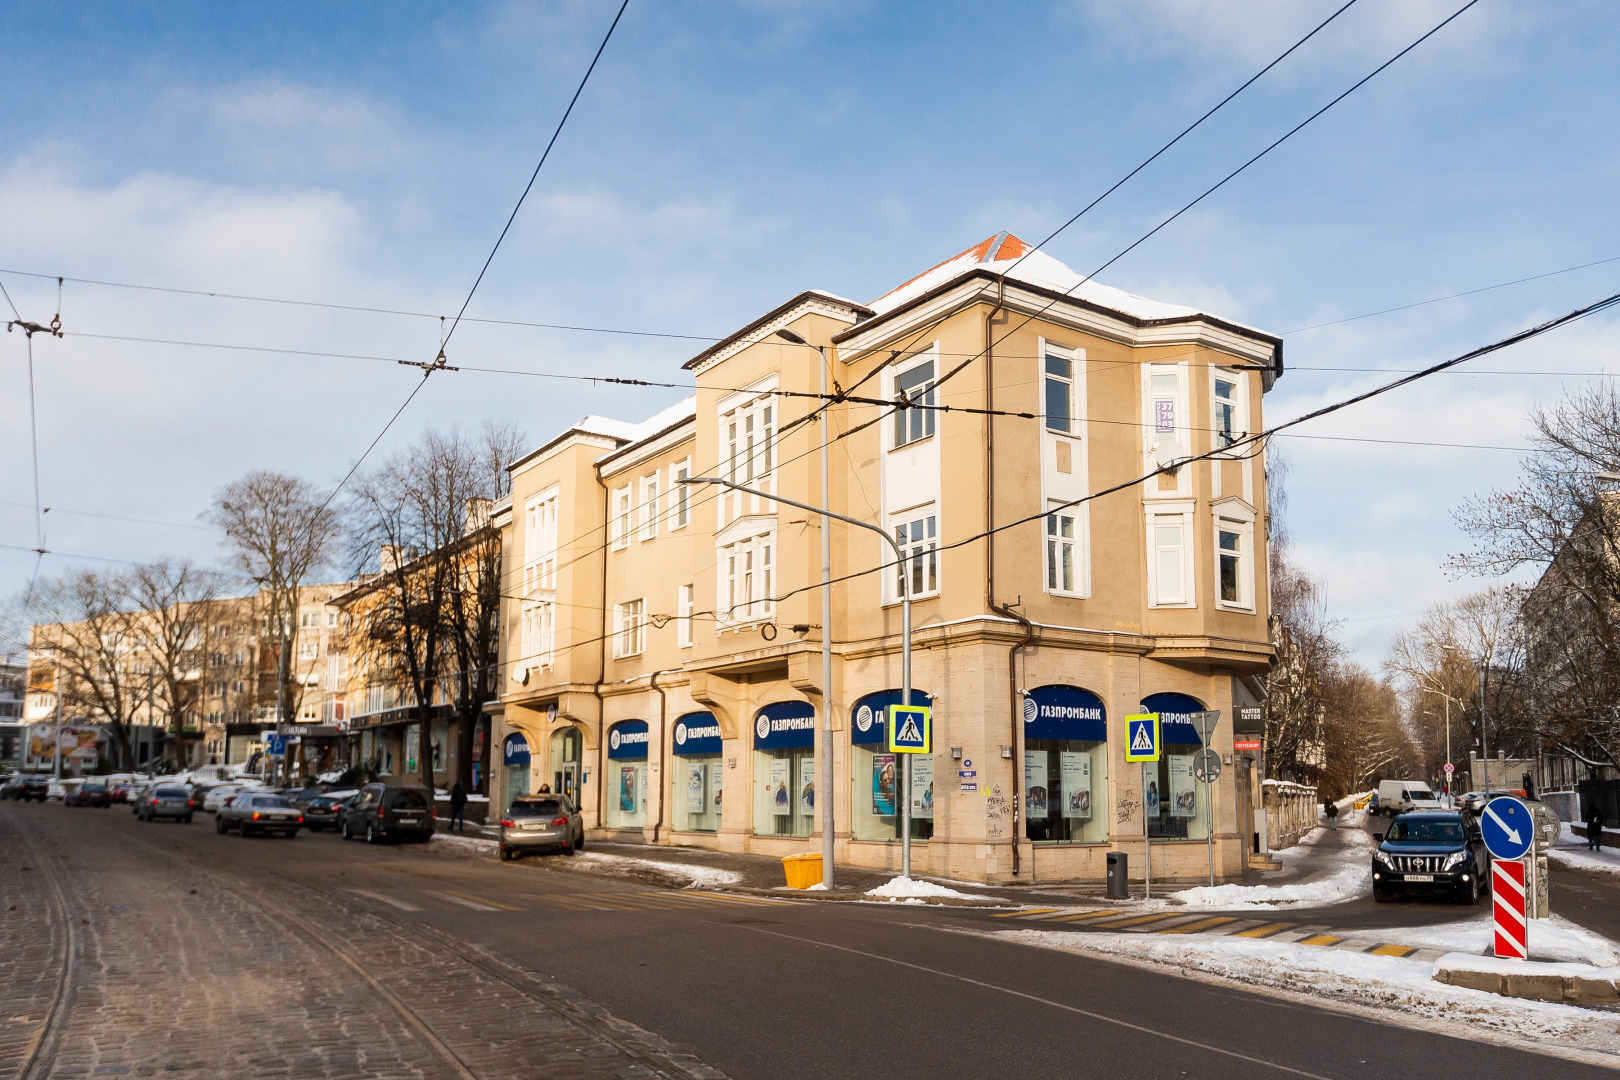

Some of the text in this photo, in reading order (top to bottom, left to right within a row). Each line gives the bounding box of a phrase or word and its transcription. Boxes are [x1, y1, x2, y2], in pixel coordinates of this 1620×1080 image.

[1161, 402, 1173, 411] 37
[1161, 411, 1173, 420] 70
[1161, 420, 1173, 429] 03
[1040, 705, 1101, 720] ГАЗПРОМБАНК
